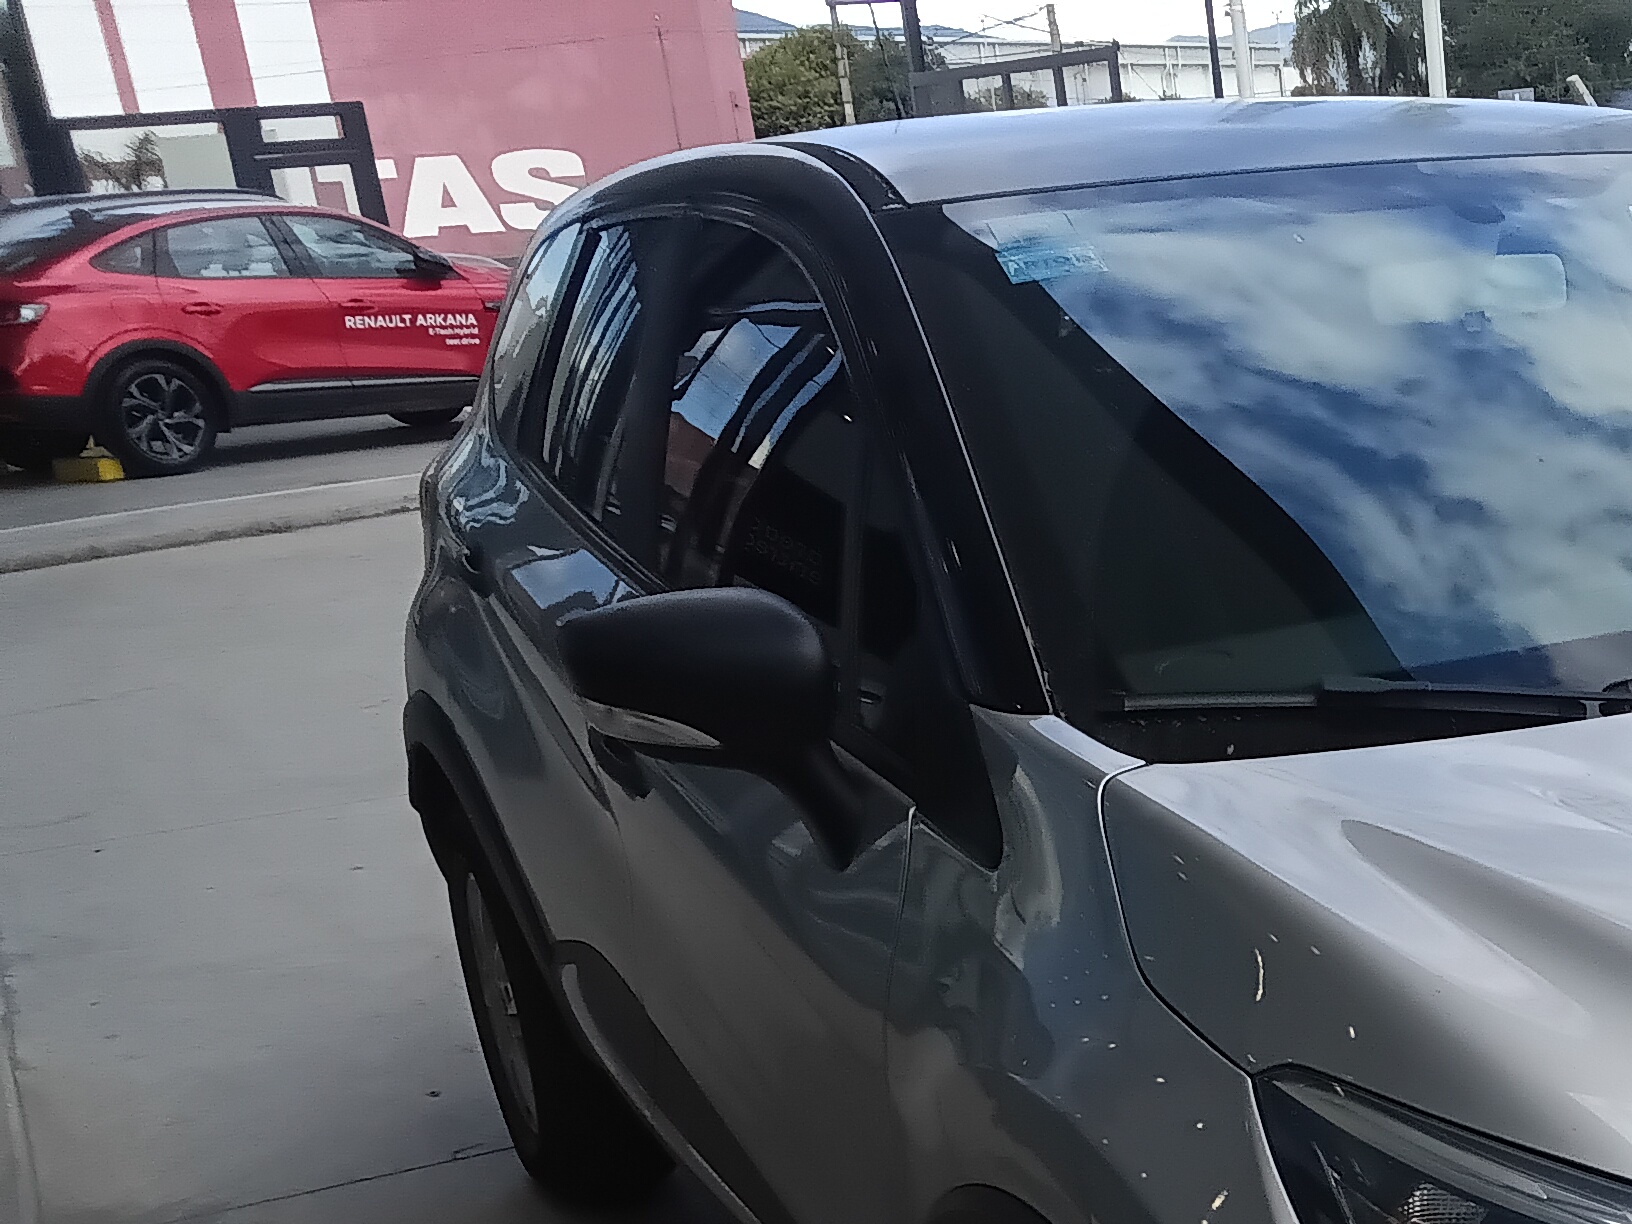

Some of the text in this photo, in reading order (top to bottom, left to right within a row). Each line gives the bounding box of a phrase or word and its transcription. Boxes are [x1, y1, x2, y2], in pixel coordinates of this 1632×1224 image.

[280, 148, 586, 238] TAS
[344, 313, 478, 329] RENAULT ARKANA
